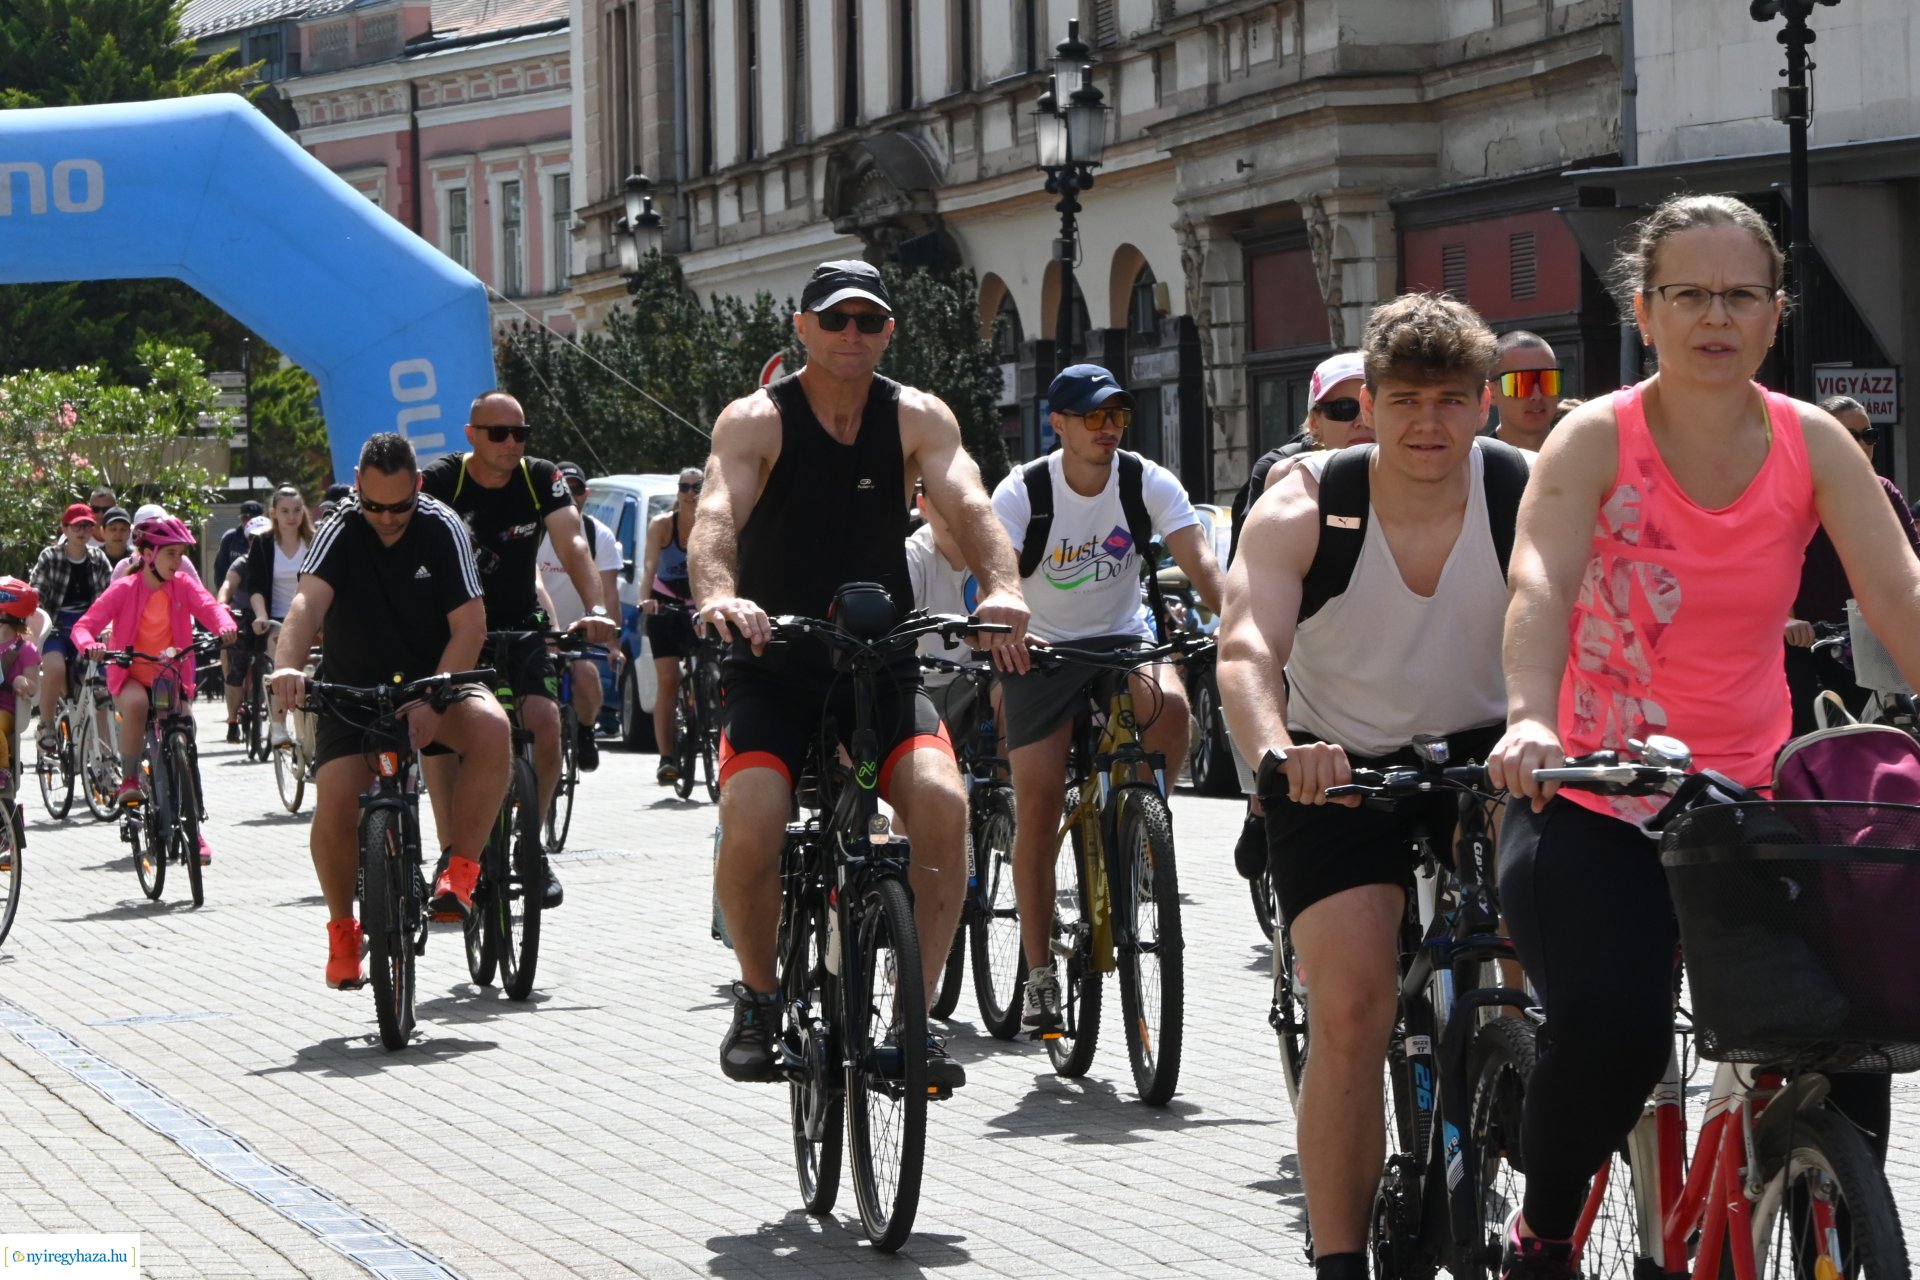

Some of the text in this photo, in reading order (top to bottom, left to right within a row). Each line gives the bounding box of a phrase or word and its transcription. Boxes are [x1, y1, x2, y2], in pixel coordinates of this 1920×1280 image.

[1817, 372, 1893, 394] VIGYÁZZ
[389, 358, 448, 468] no
[1057, 535, 1099, 569] Just
[1094, 560, 1121, 582] Do
[1414, 1062, 1433, 1112] 26
